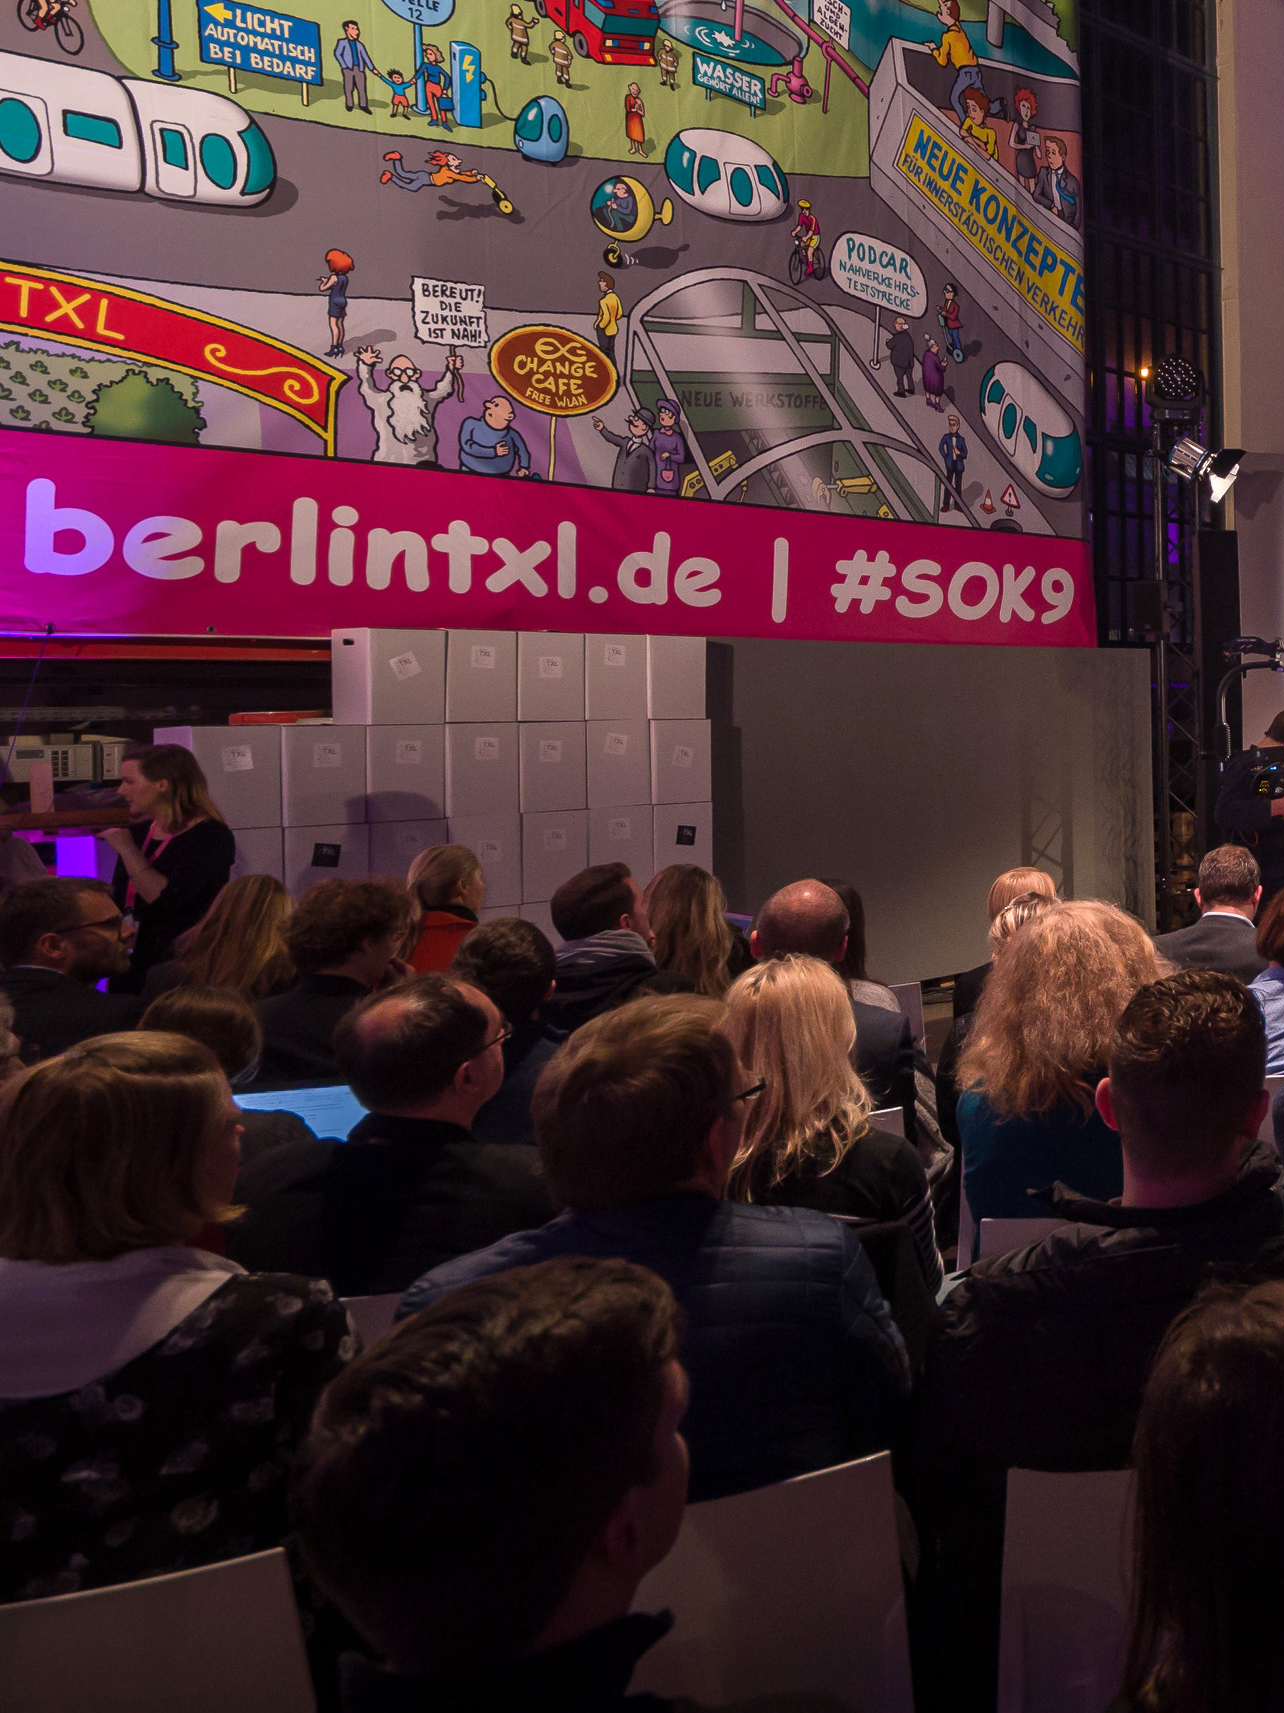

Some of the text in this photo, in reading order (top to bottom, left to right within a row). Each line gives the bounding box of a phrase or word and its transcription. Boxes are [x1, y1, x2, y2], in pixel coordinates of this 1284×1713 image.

[235, 8, 293, 38] LICHT
[408, 7, 424, 21] 12
[820, 17, 843, 40] ZUCHT
[204, 23, 315, 62] AUTOMATISCH
[209, 43, 317, 79] BEI BEDARF
[696, 57, 762, 98] WASSER
[697, 73, 760, 106] GEHÖRT ALLEN!
[901, 153, 923, 180] FÜR
[922, 173, 1025, 282] INNERSTÄDTISCHEN
[913, 128, 1084, 315] NEUE KONZEPTE
[846, 237, 912, 281] PODCAR
[421, 283, 481, 303] BEREUT!
[839, 259, 920, 297] NAHVERKEHRS-
[5, 276, 125, 340] TXL
[439, 300, 462, 312] DIE
[847, 277, 911, 311] TESTSTRECKE
[420, 310, 482, 328] ZUKUNFT
[428, 327, 482, 344] IST NAH!
[513, 354, 598, 378] CHANGE
[526, 387, 588, 407] FREE WLAN
[531, 373, 584, 395] CAFE
[681, 390, 722, 408] NEUE
[23, 478, 722, 608] berlintxl.de
[833, 549, 1074, 625] #SOK9
